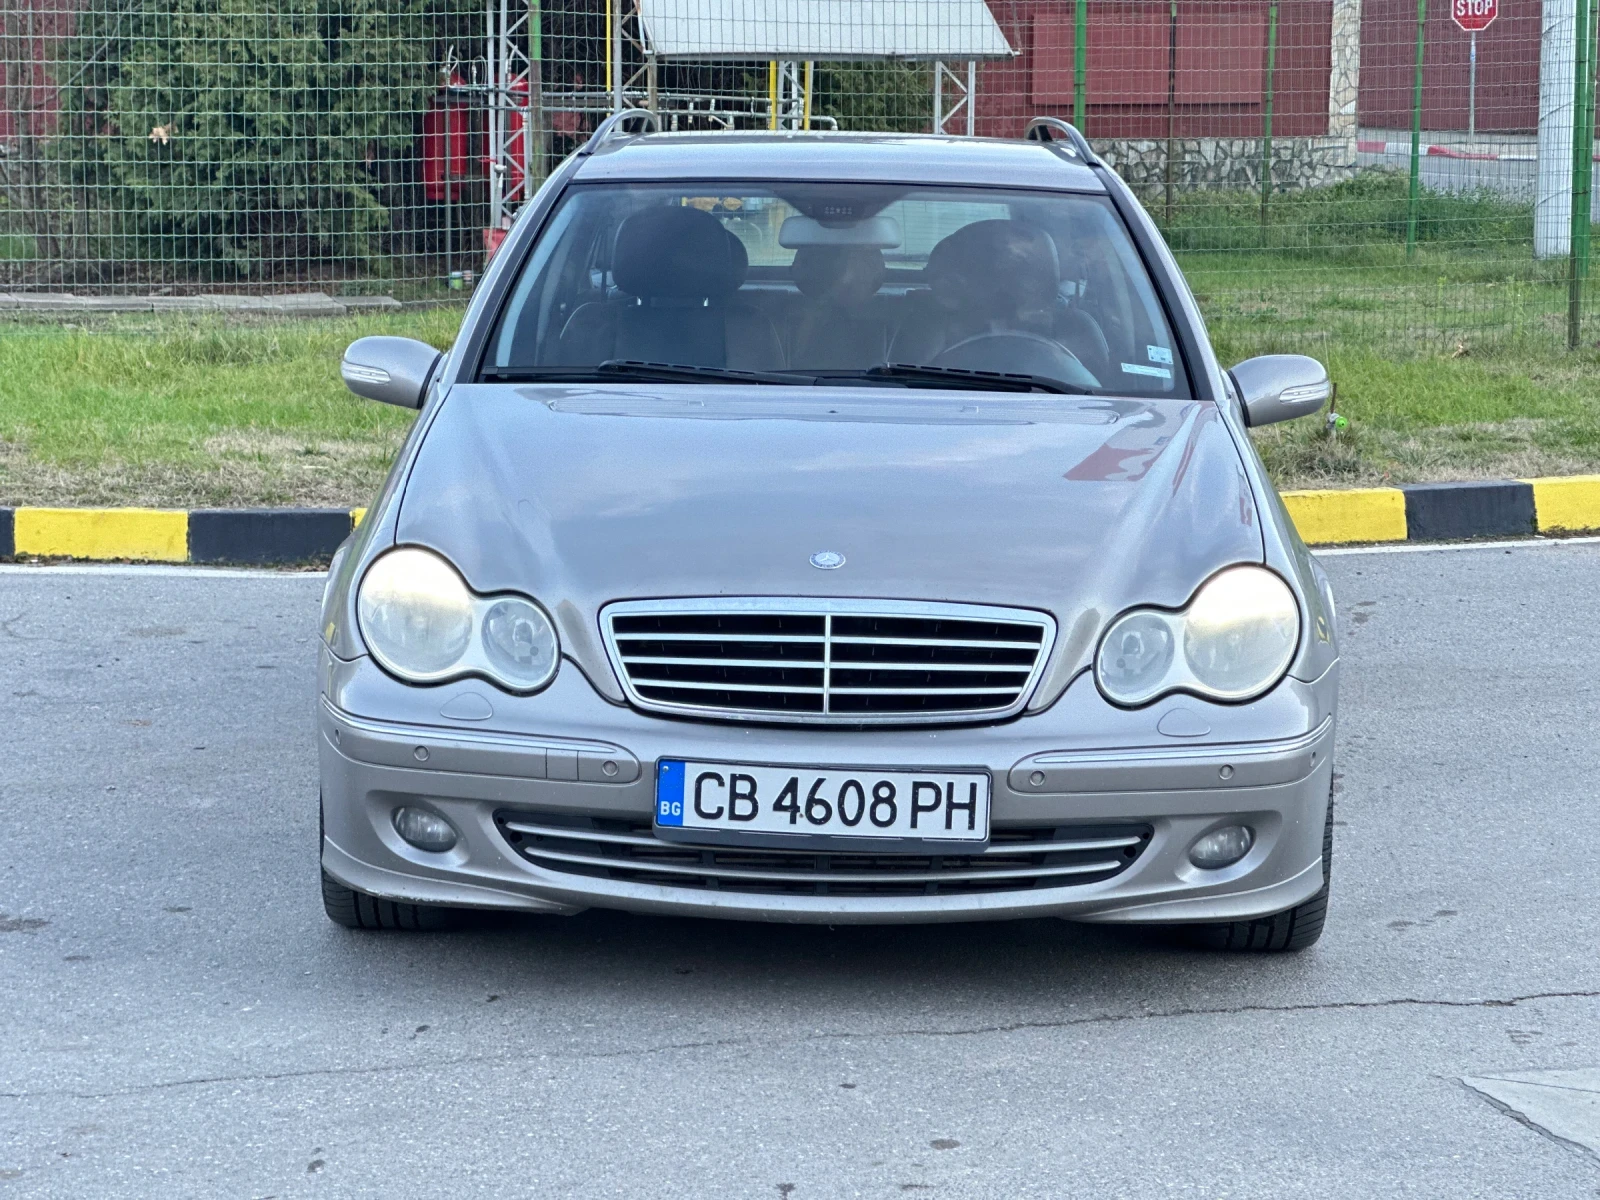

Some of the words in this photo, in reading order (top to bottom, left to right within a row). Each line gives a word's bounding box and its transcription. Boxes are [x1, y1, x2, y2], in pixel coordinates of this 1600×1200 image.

[1456, 0, 1493, 16] STOP
[660, 800, 681, 816] BG
[694, 771, 759, 822] CB
[772, 776, 898, 828] 4608
[909, 780, 978, 831] PH
